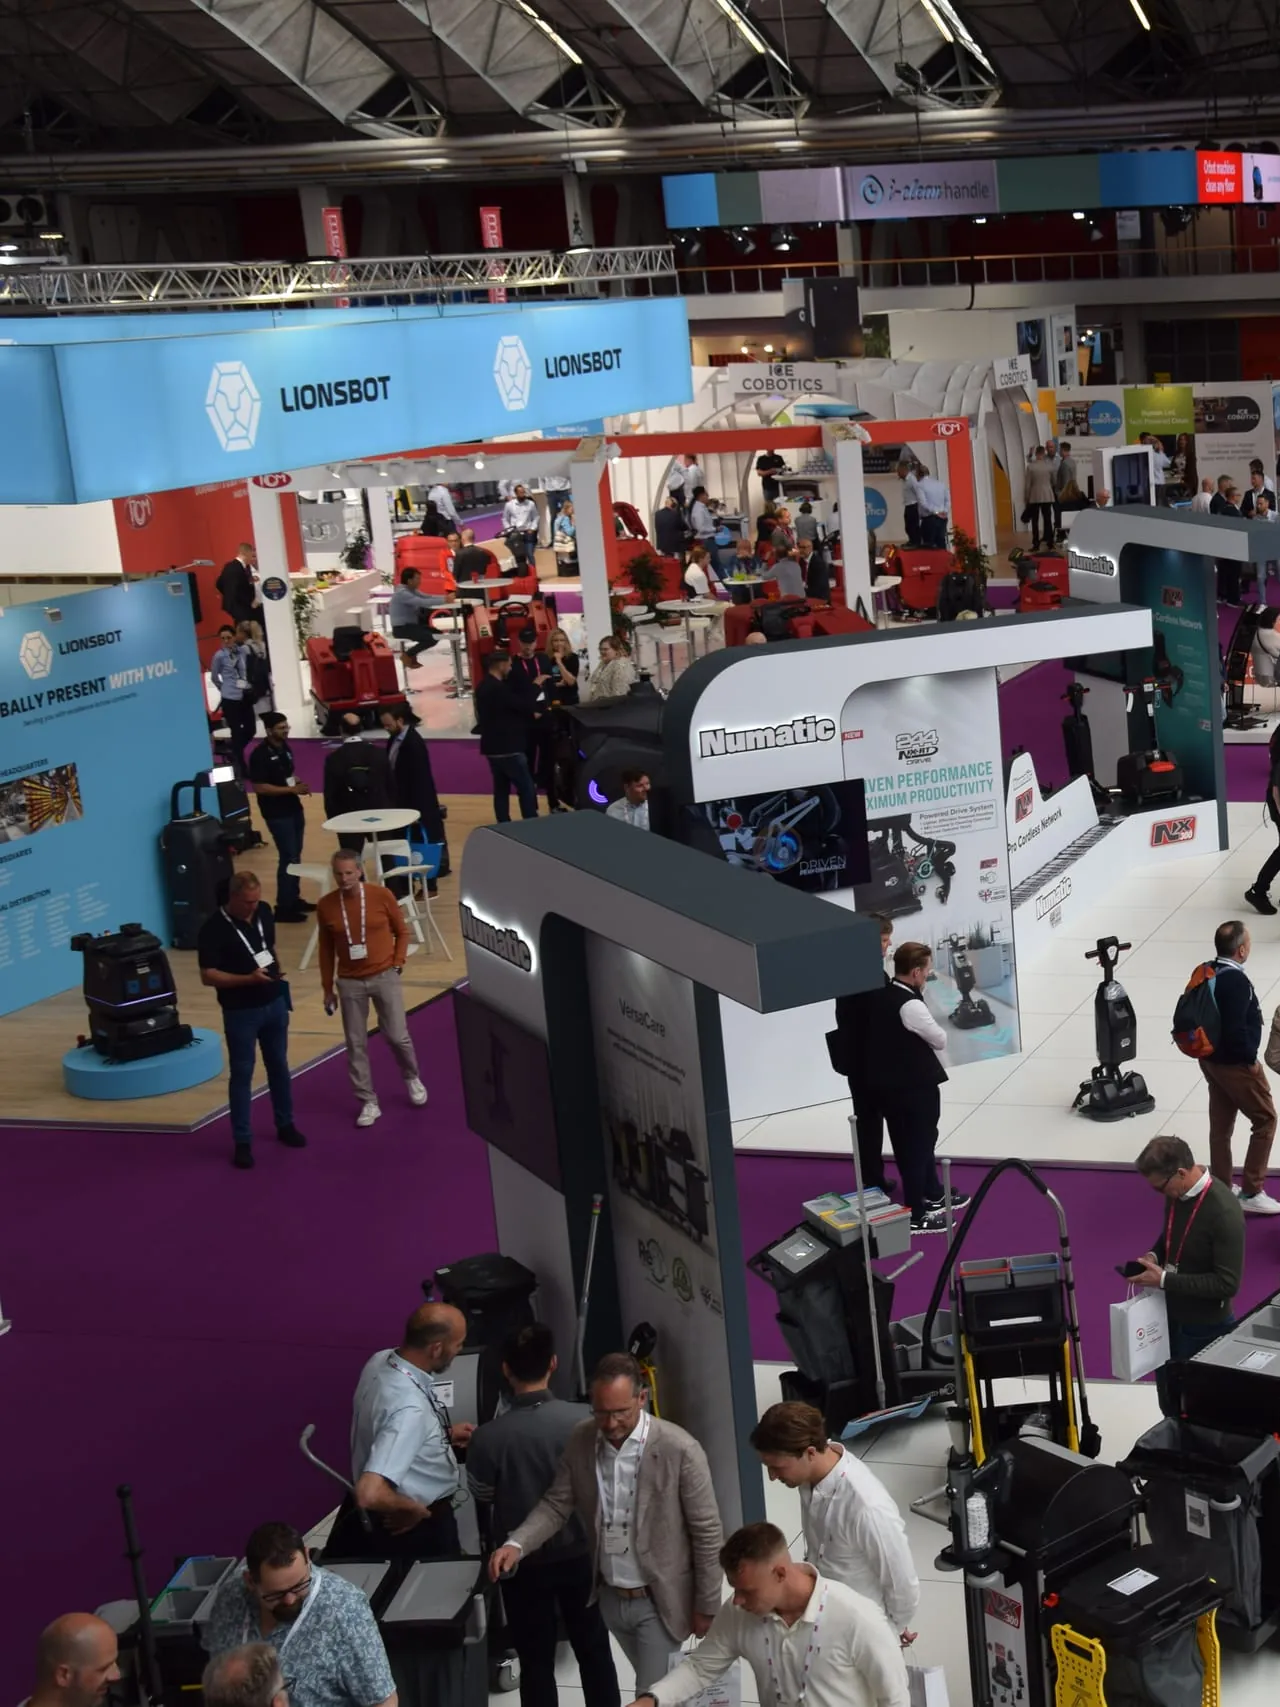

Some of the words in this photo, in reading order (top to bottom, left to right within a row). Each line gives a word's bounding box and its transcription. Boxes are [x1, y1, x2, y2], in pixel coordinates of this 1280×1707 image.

[544, 348, 622, 379] LIONSBOT
[1000, 369, 1029, 386] COBOTICS
[279, 376, 391, 413] LIONSBOT
[742, 378, 823, 391] COBOTICS
[1068, 550, 1115, 577] Numatic
[58, 629, 123, 656] LIONSBOT
[46, 677, 107, 706] PRESENT
[109, 666, 145, 690] WITH
[146, 659, 178, 680] YOU.
[699, 715, 836, 758] Numatic
[895, 729, 940, 751] 244
[897, 760, 993, 789] PERFORMANCE
[905, 757, 932, 766] DRIVE
[865, 791, 907, 811] XIMUM
[909, 778, 994, 805] PRODUCTIVITY
[919, 810, 949, 821] Powered
[950, 807, 968, 816] Drive
[968, 803, 994, 814] System
[1017, 825, 1041, 847] Cordless
[1040, 806, 1062, 832] Network
[800, 855, 847, 871] DRIVEN
[1035, 876, 1073, 921] Numatic
[459, 902, 532, 973] Numatic
[619, 998, 667, 1038] VersaCare
[1005, 1613, 1020, 1628] 300
